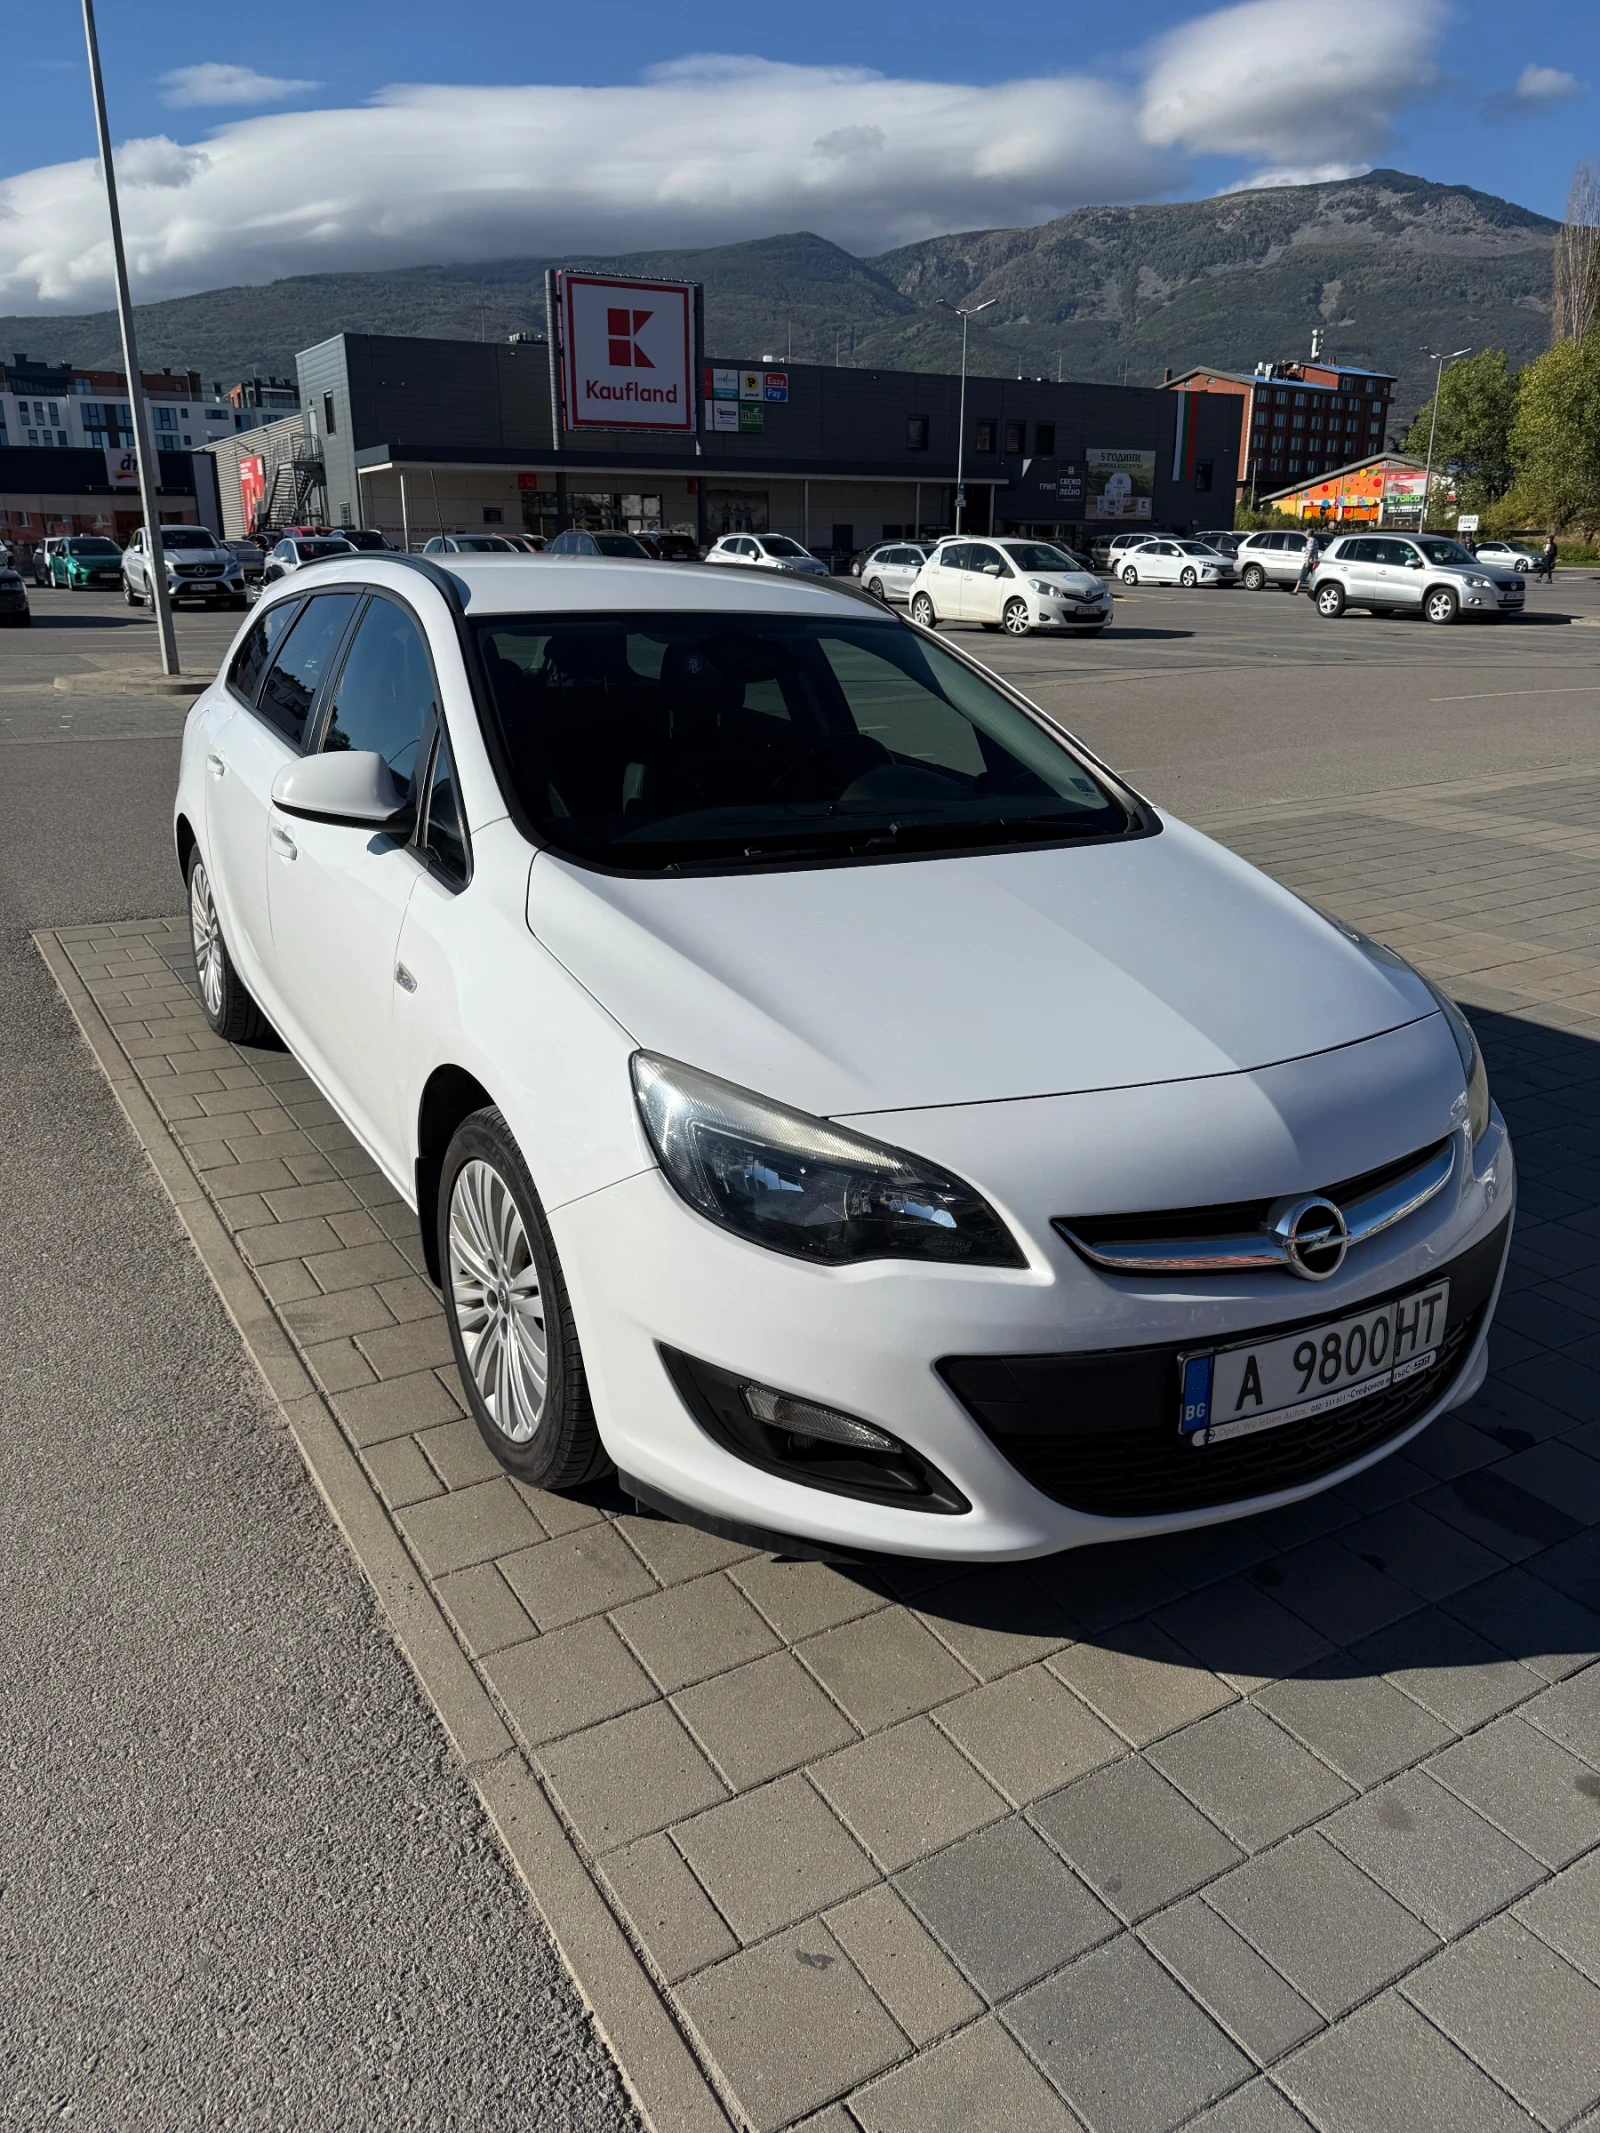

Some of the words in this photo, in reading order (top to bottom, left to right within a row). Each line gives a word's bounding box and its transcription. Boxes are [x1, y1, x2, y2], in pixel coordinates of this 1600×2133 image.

[767, 376, 785, 387] Easy
[586, 379, 678, 404] Kaufland
[767, 388, 782, 400] Pay
[742, 411, 762, 420] Rois
[1100, 452, 1106, 461] 5
[1107, 452, 1141, 463] ГОДИНИ
[1039, 482, 1057, 490] ГРИЛ
[1059, 488, 1081, 496] ЛЕСНО
[1235, 1355, 1263, 1411] A
[1185, 1402, 1206, 1421] BG
[1218, 1425, 1241, 1437] Opel.
[1243, 1420, 1258, 1430] Wir
[1258, 1415, 1281, 1426] leben
[1283, 1408, 1308, 1420] Autos.
